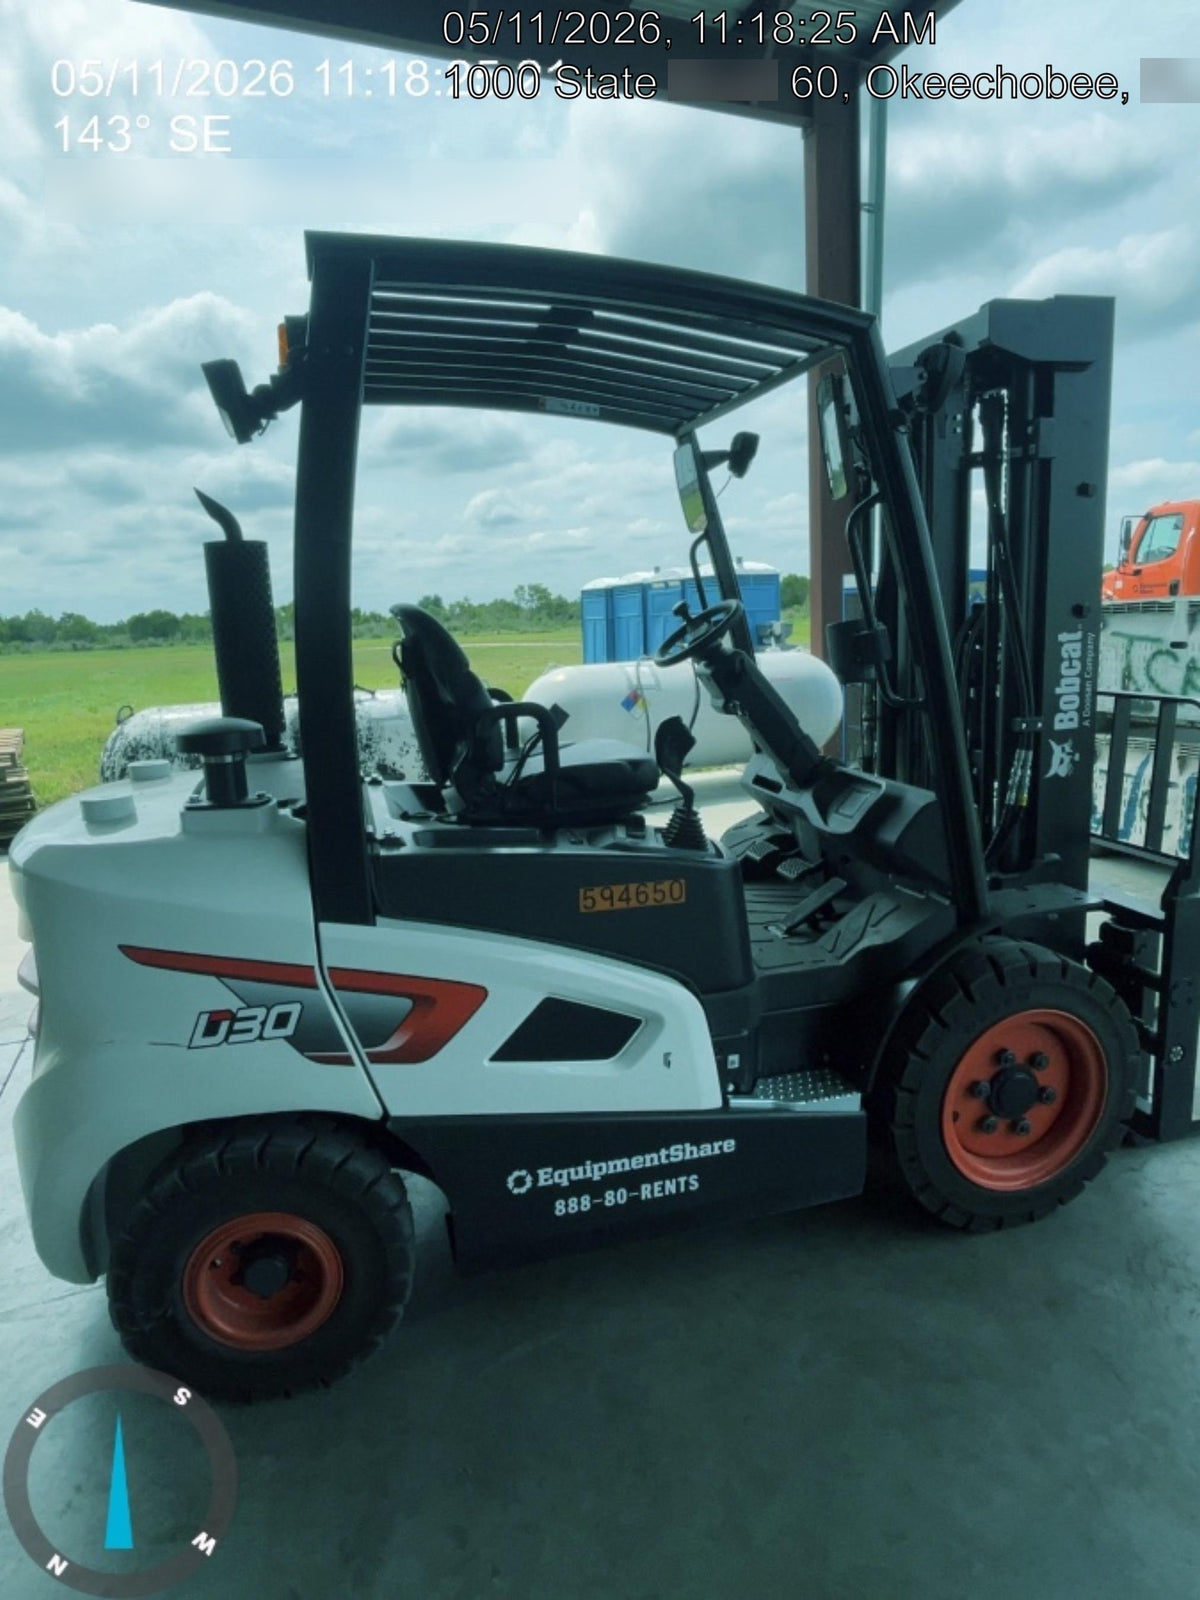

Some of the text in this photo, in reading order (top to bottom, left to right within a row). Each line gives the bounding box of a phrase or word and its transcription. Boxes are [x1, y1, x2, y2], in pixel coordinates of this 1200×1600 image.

[1084, 632, 1096, 678] Company
[1053, 630, 1083, 731] Bobcat
[582, 879, 684, 910] 594650
[188, 1001, 303, 1050] D30
[536, 1138, 736, 1187] EquipmentShare
[554, 1174, 700, 1216] 888-80-RENTS
